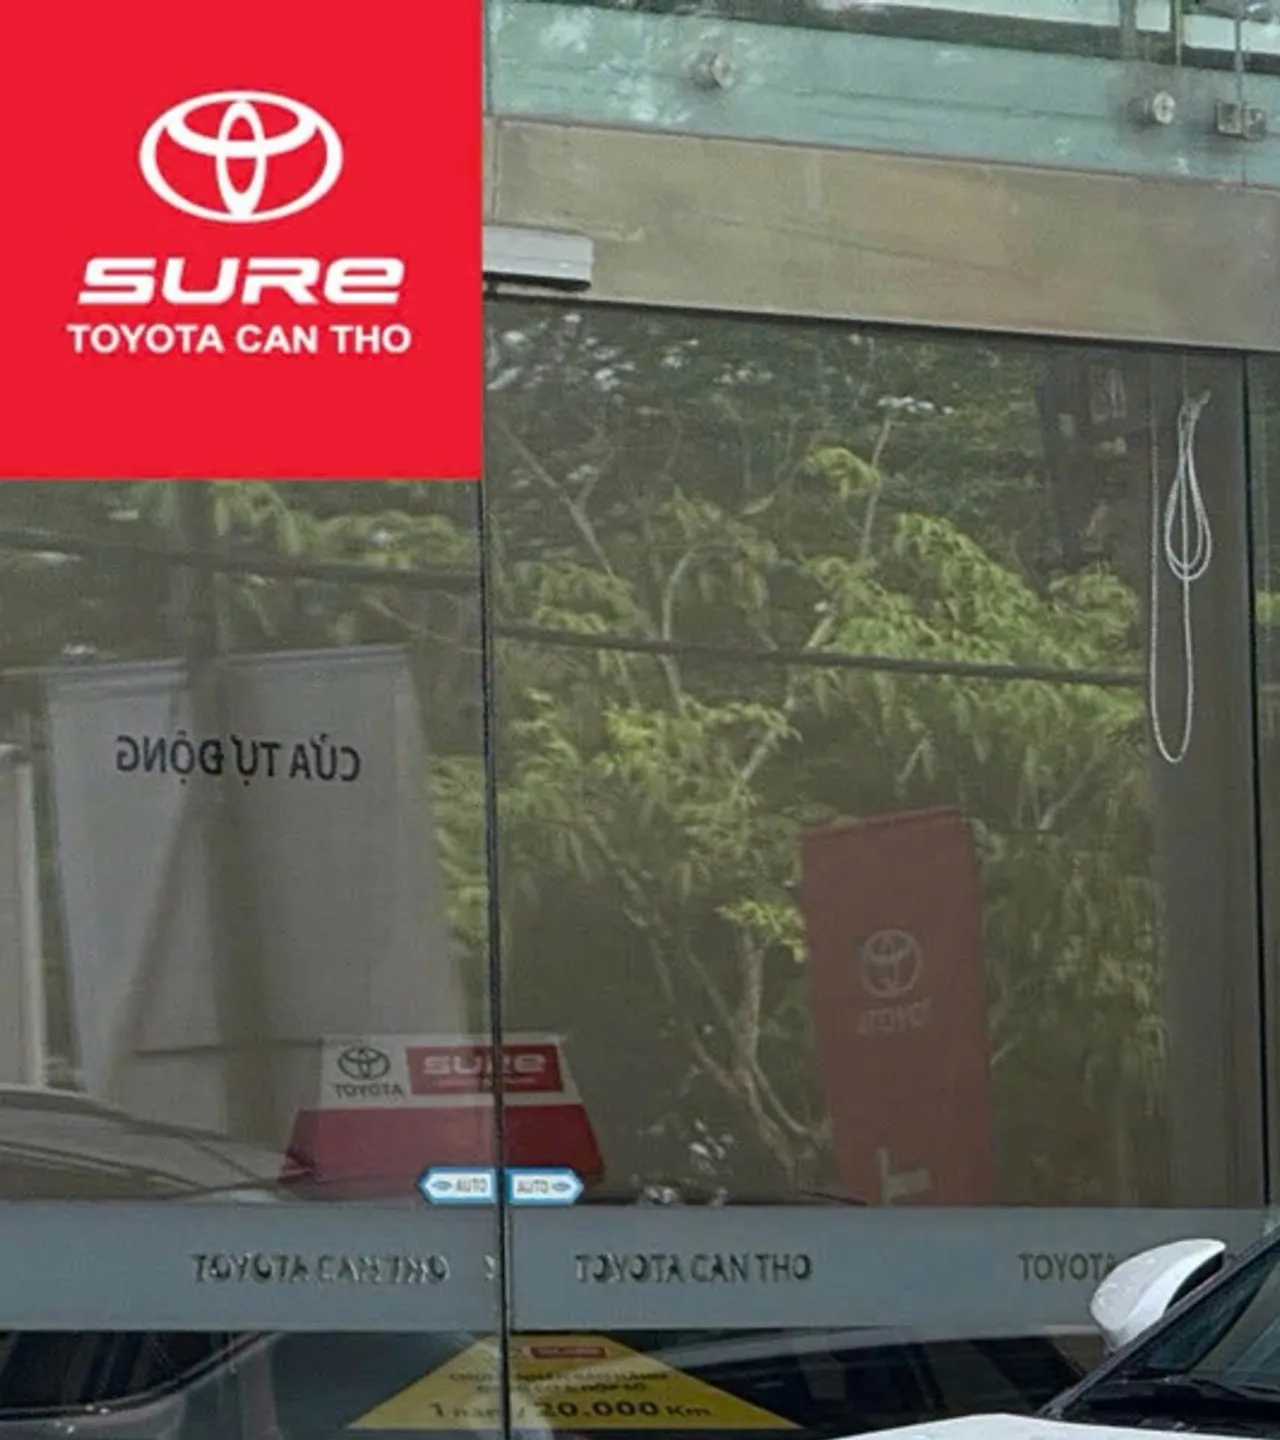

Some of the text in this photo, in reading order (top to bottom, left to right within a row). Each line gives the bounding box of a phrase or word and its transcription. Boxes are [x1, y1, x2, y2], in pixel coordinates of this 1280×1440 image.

[335, 1083, 405, 1100] TOYOTA
[455, 1179, 488, 1194] AUTO
[516, 1180, 549, 1194] AUTO
[192, 1254, 308, 1283] TOYOTA
[319, 1254, 382, 1283] CAN
[574, 1254, 813, 1283] TOYOTA CAN THO
